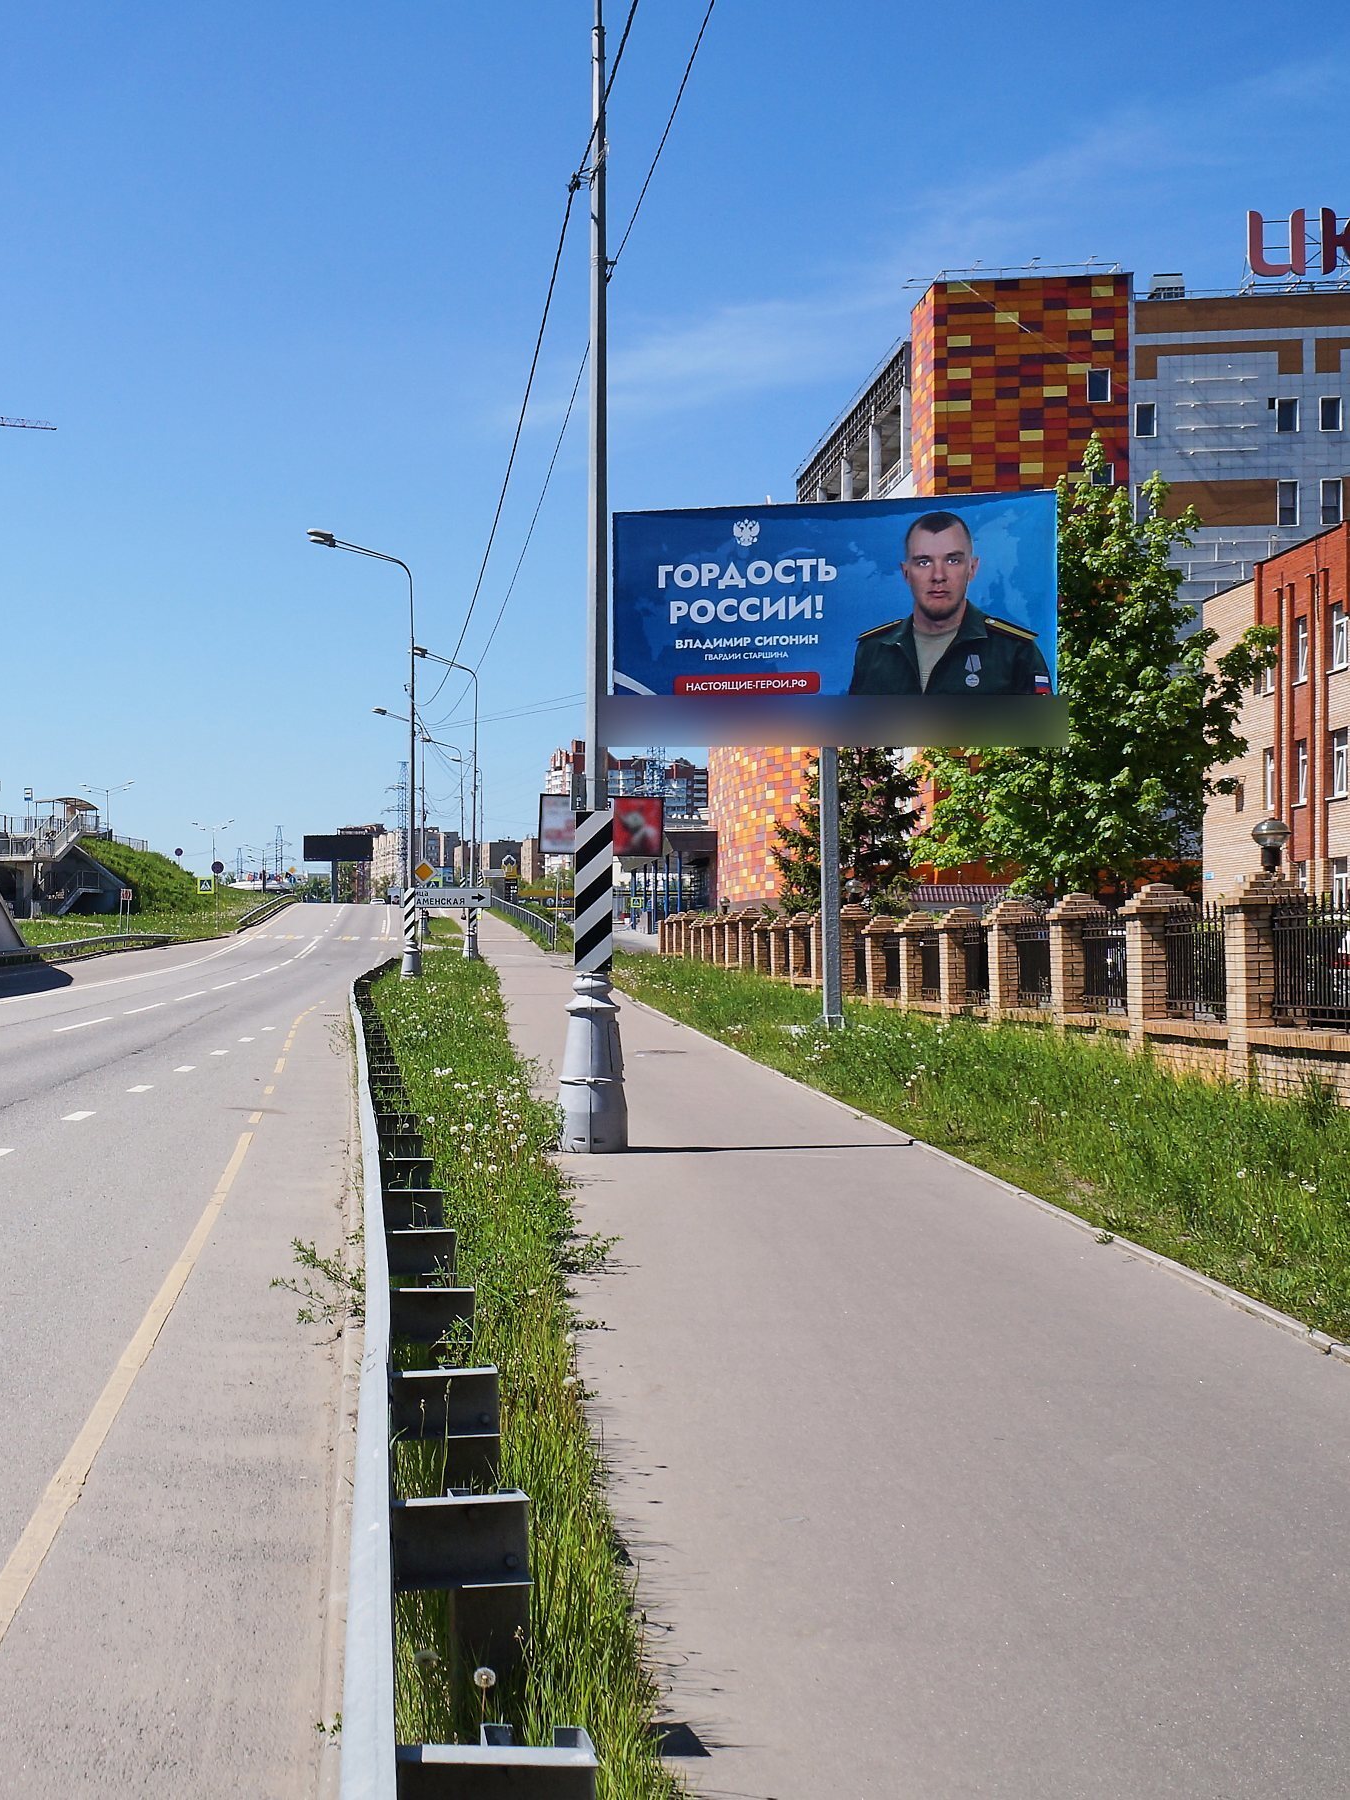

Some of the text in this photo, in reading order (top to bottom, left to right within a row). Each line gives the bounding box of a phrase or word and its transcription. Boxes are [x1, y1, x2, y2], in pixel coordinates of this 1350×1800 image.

[657, 558, 838, 589] ГОРДОСТЬ
[669, 595, 824, 624] РОССИИ!
[675, 634, 819, 650] ВЛАДИМИР СИГОНИН
[704, 651, 789, 661] ГВАРДИИ СТАРШИНА
[686, 679, 808, 692] НАСТОЯЩИЕ-ГЕРОИ.РФ
